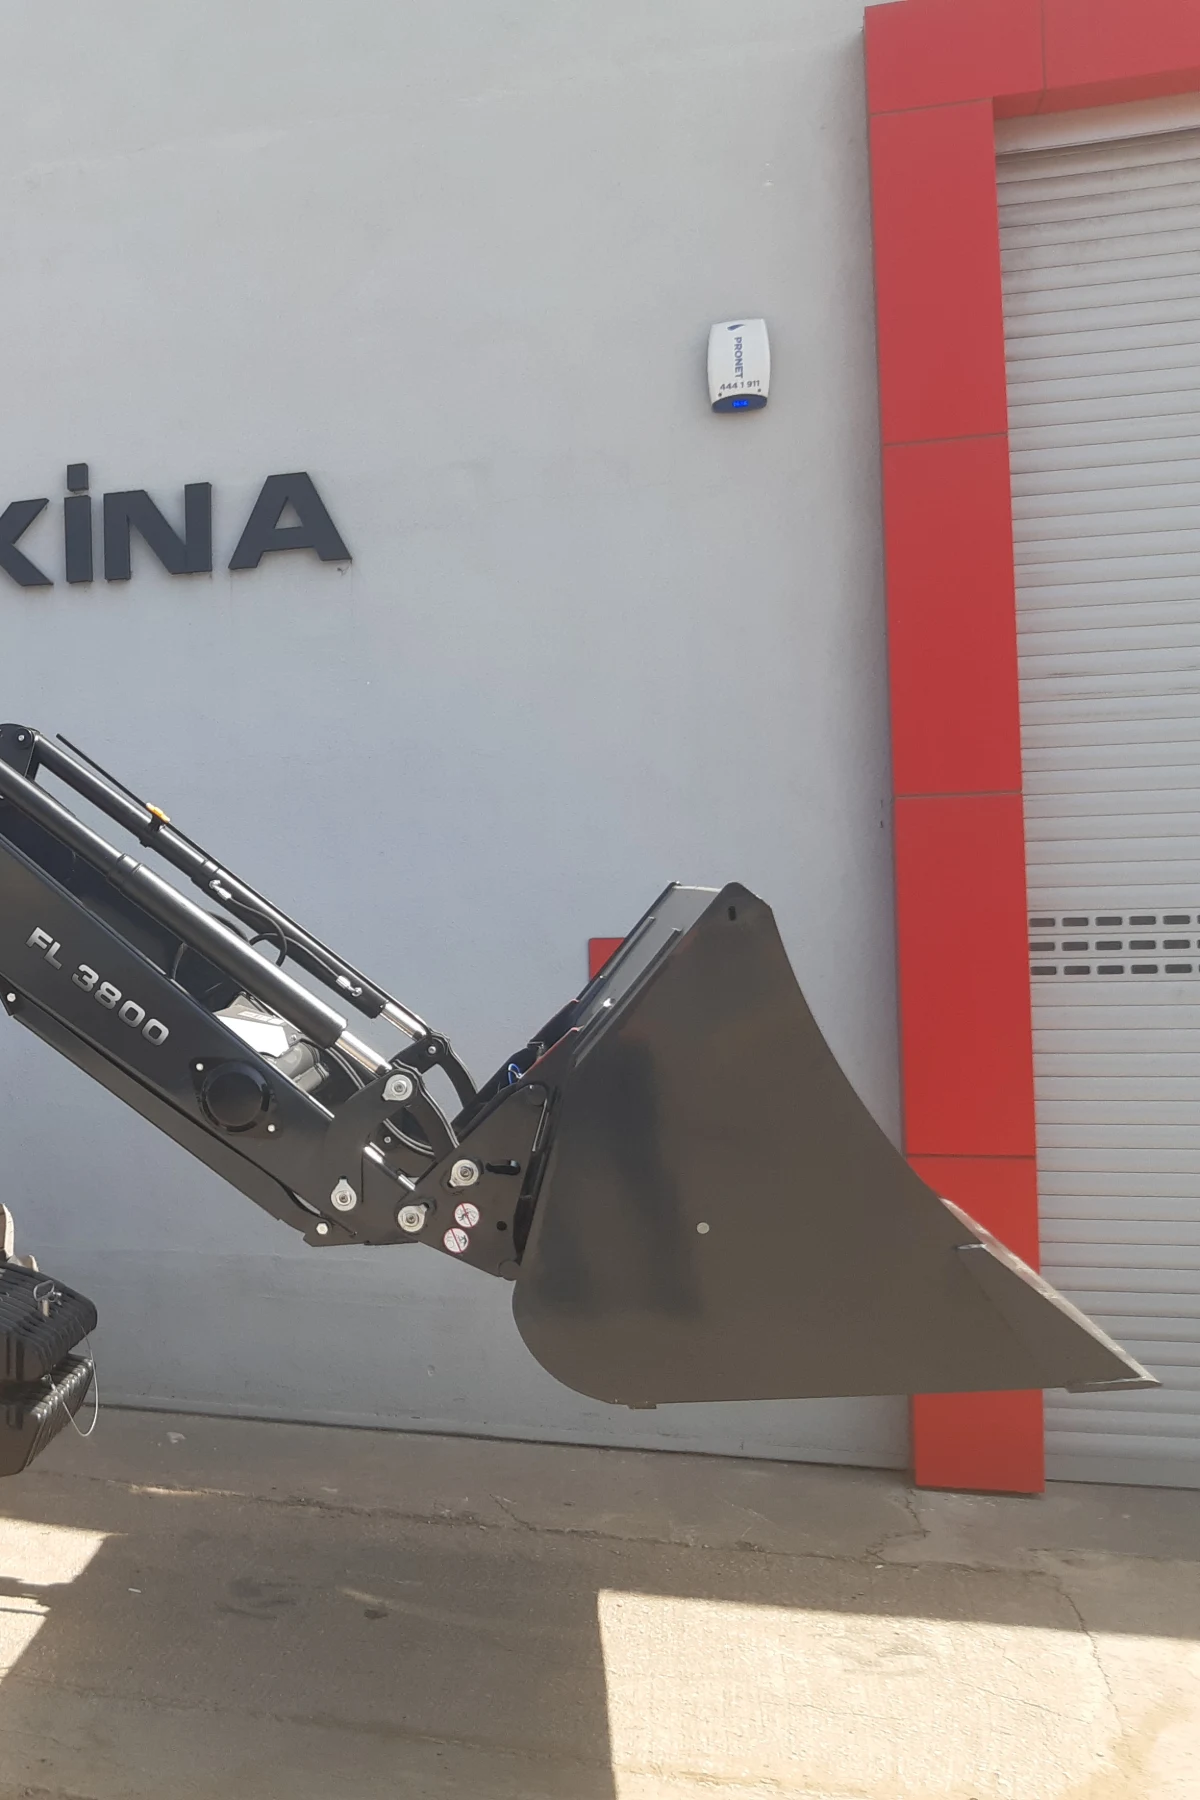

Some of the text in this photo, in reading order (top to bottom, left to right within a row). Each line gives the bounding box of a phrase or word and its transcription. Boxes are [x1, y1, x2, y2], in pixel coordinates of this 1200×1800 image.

[733, 336, 744, 378] PRONET
[720, 382, 738, 391] 444
[747, 380, 760, 388] 911
[25, 927, 170, 1046] FL 3800
